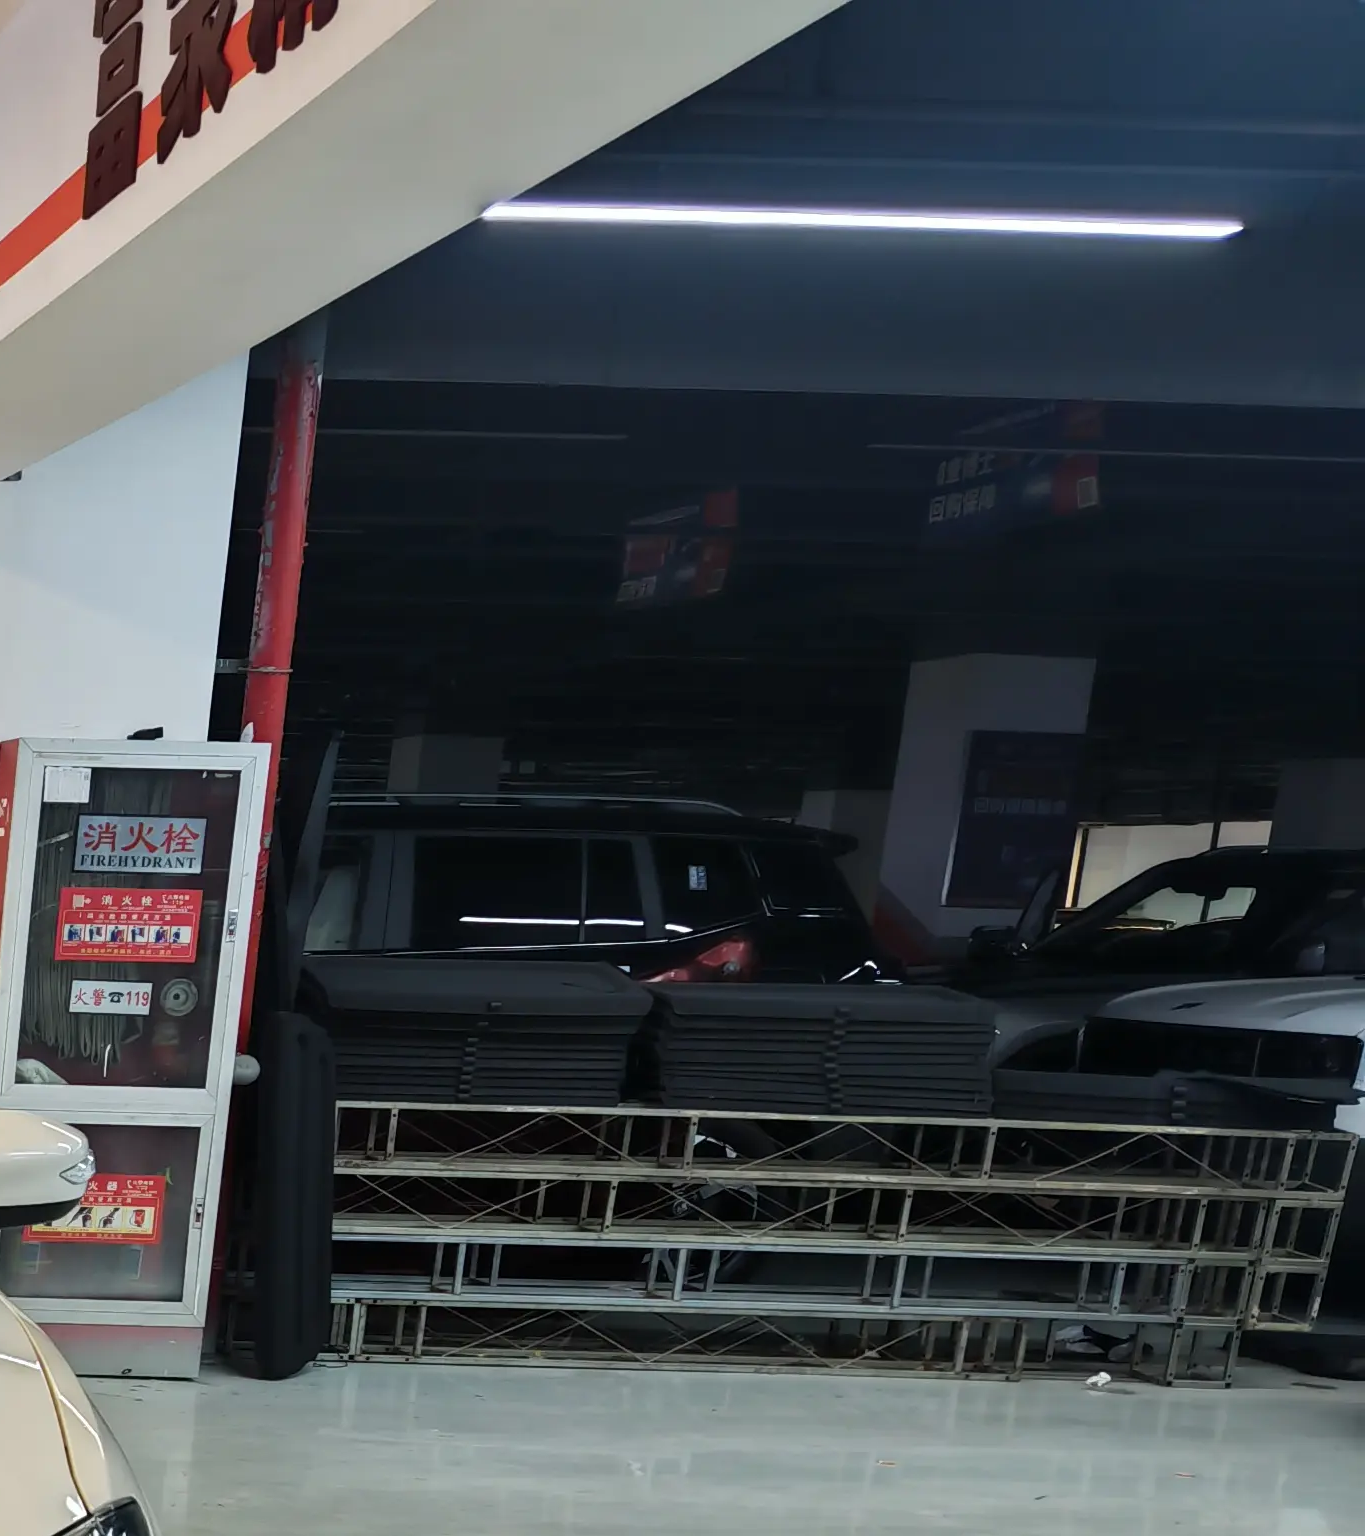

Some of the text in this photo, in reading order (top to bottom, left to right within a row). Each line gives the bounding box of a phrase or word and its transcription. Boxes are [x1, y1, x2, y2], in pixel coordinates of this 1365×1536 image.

[83, 822, 200, 854] 消火栓
[80, 854, 196, 869] FIREHYDRANT
[101, 895, 153, 906] 消火栓
[72, 988, 150, 1007] 火警 119
[88, 1180, 118, 1191] 火器
